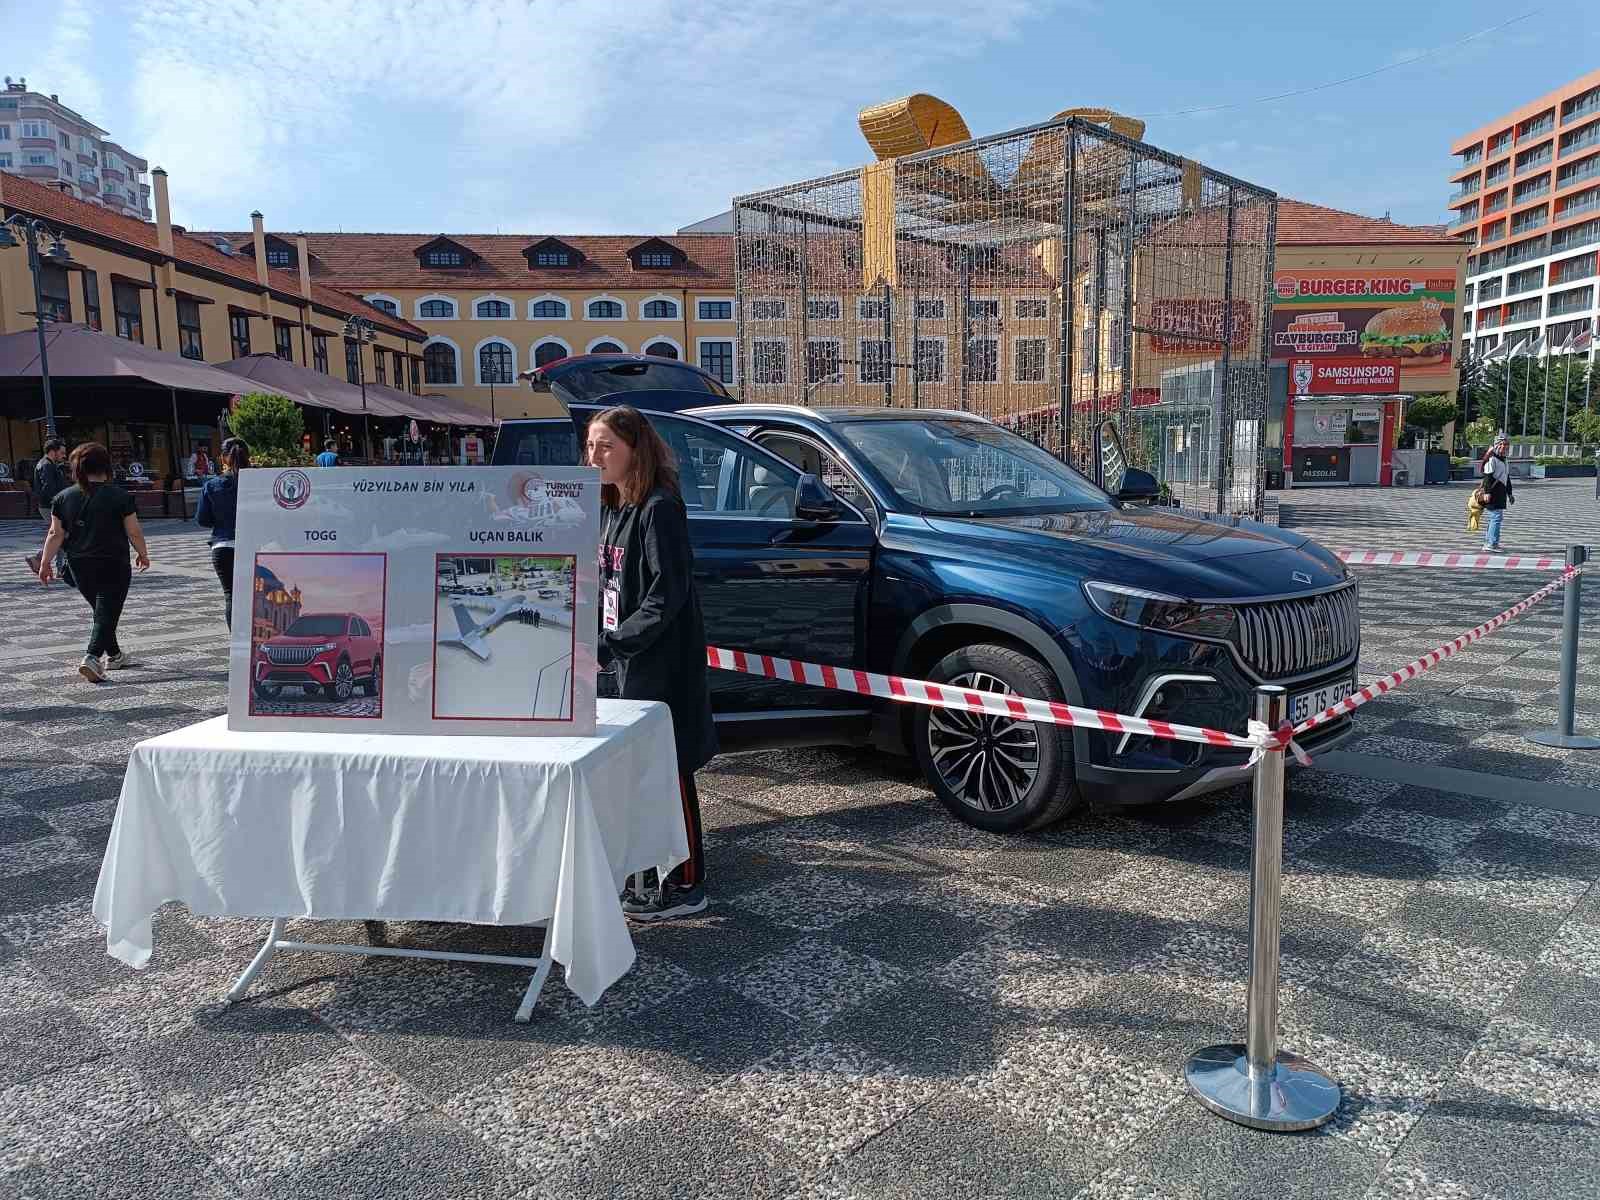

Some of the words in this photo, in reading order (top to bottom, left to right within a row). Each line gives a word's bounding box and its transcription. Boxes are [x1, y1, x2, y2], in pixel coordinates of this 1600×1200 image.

[1299, 278, 1365, 296] BURGER
[1370, 278, 1412, 294] KING
[1318, 366, 1395, 378] SAMSUNSPOR
[353, 479, 420, 493] YÜZYILDAN
[423, 481, 445, 493] BİN
[449, 481, 476, 493] YILA
[304, 530, 337, 541] TOGG
[469, 531, 505, 545] UÇAN
[507, 531, 544, 542] BALIK
[1295, 696, 1309, 720] 55
[1315, 690, 1327, 714] TS
